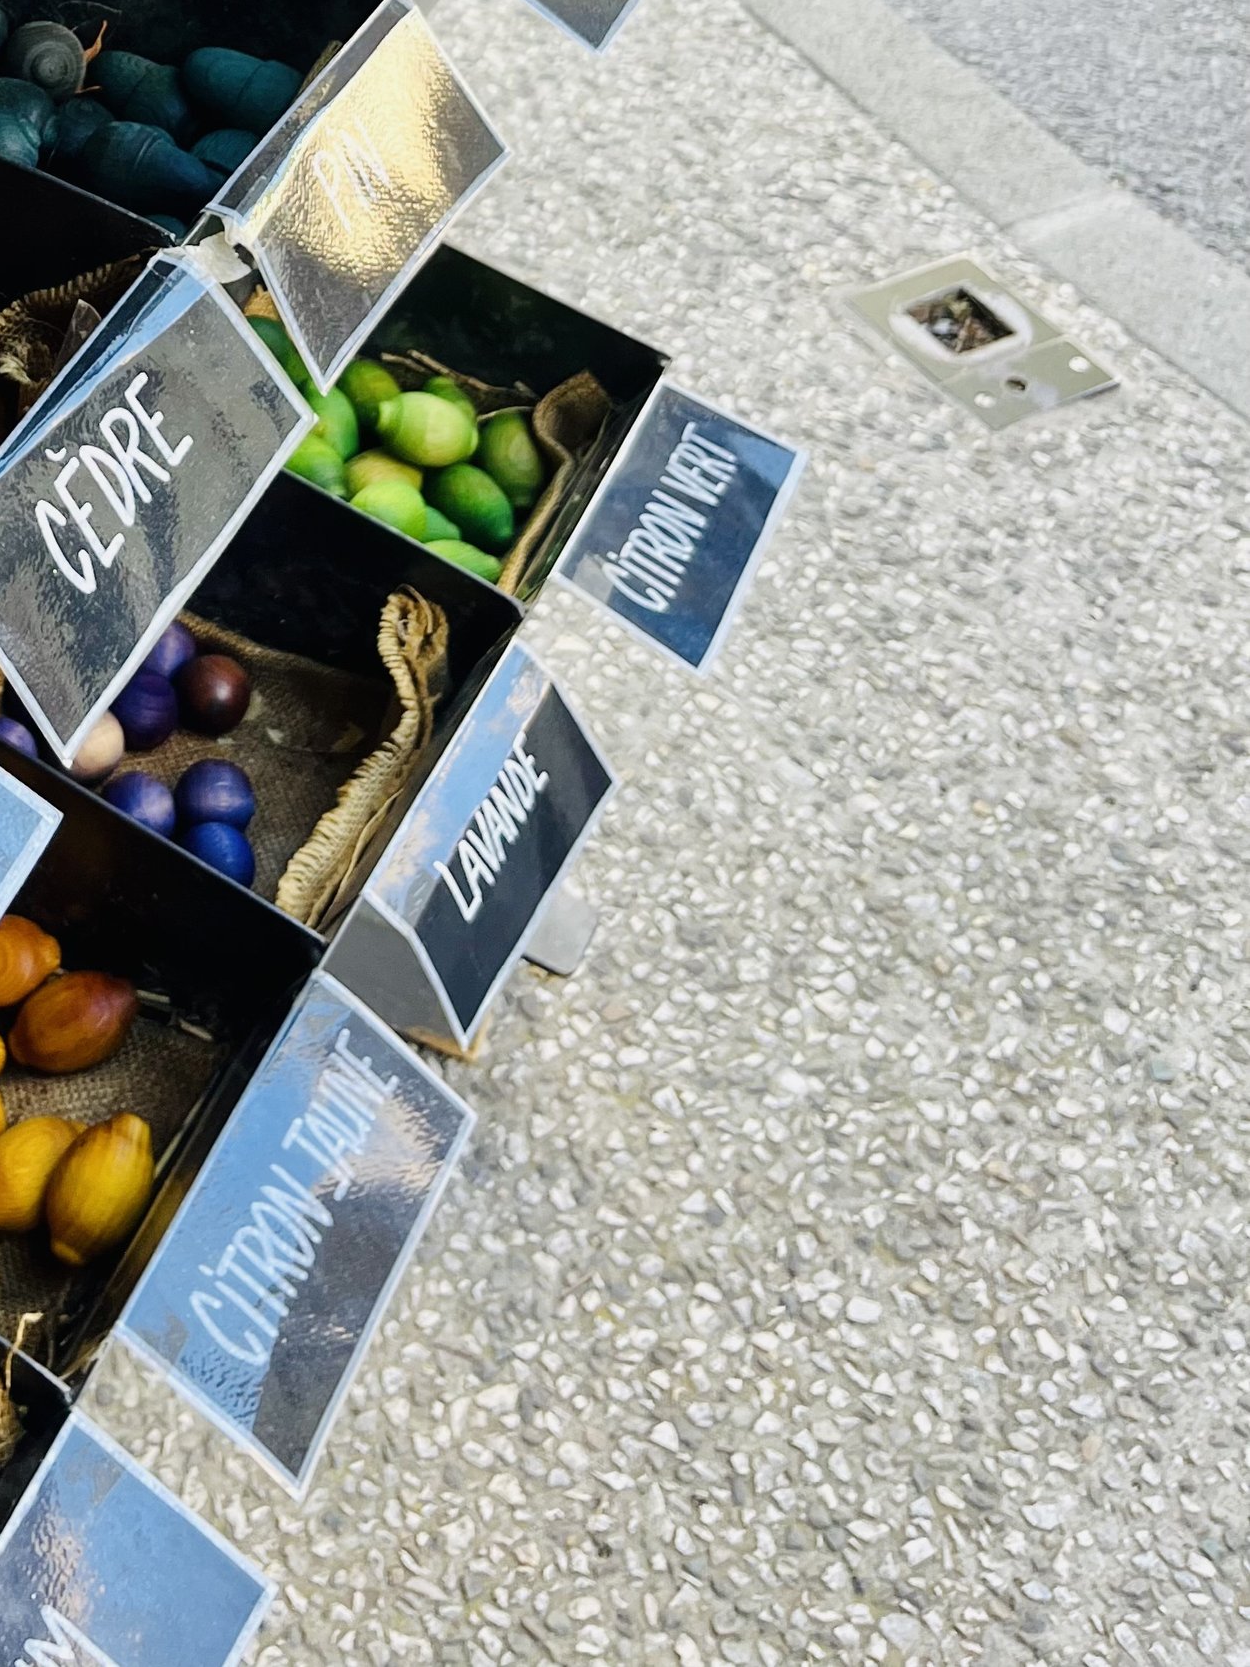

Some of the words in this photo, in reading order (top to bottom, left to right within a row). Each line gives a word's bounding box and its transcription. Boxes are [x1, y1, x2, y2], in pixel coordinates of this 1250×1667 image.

[602, 488, 711, 614] CITRON
[659, 420, 739, 508] VERT
[432, 730, 550, 925] LAVANDE
[189, 1163, 334, 1366] CITRON
